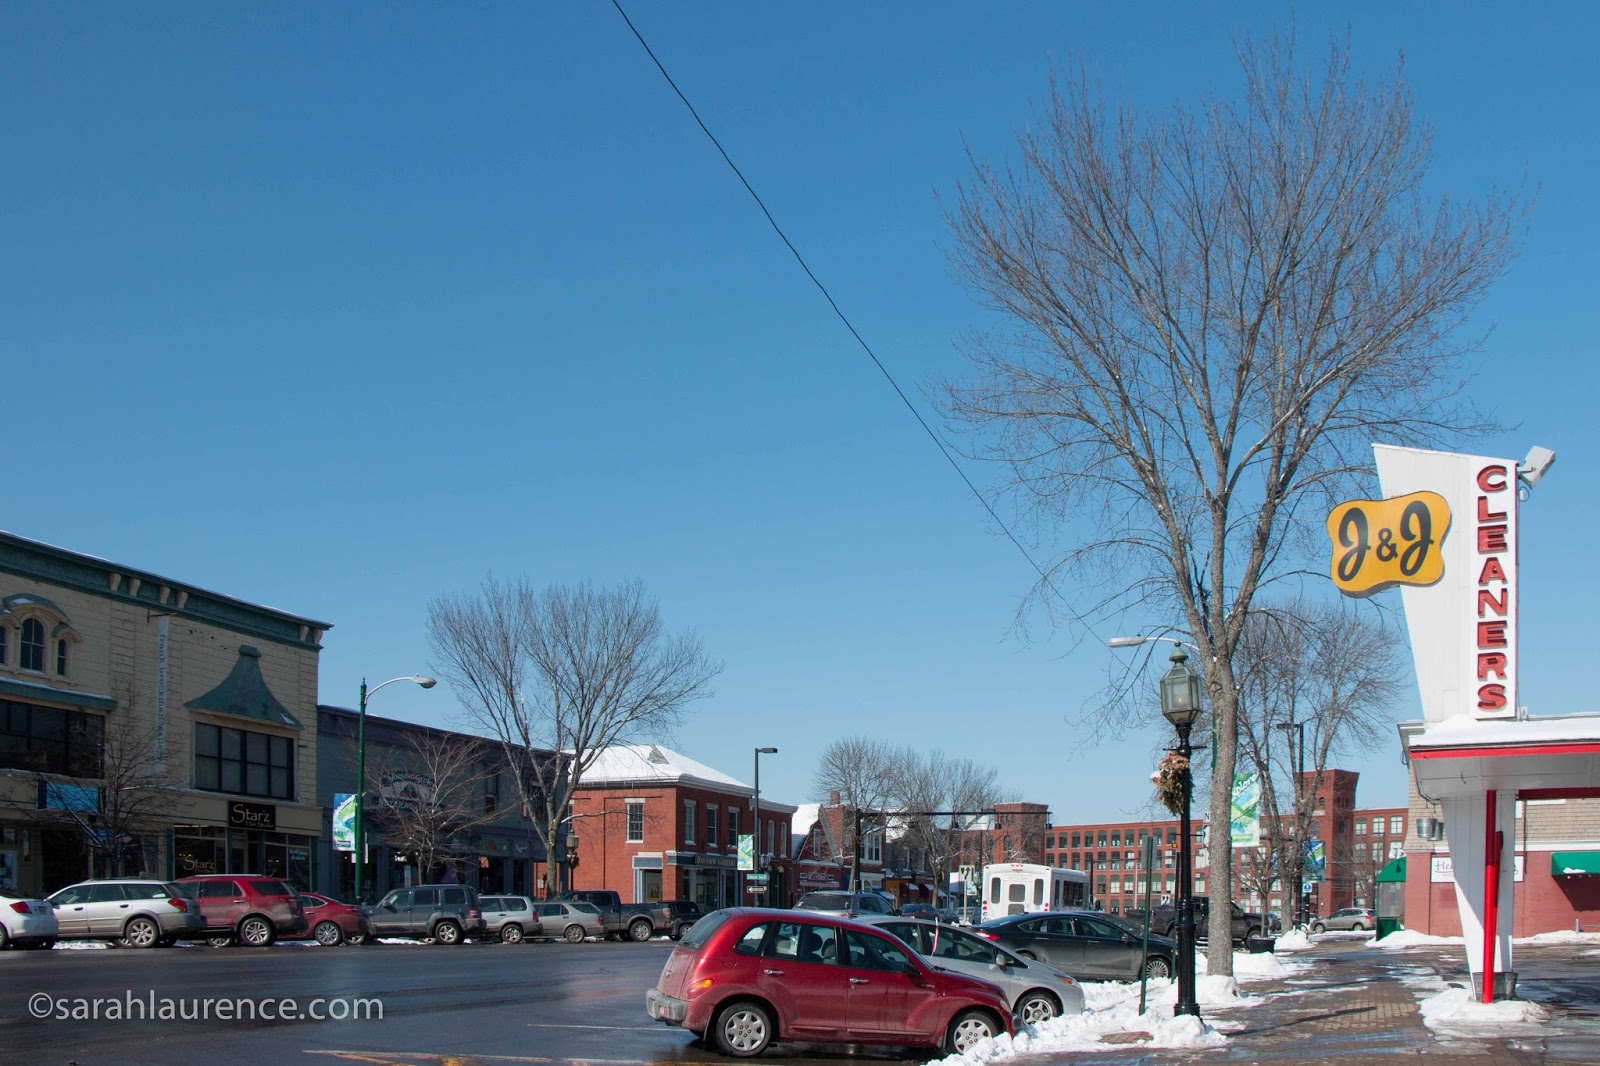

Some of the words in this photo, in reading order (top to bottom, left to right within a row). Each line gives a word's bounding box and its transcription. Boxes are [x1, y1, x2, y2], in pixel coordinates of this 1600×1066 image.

[1337, 507, 1371, 582] J
[1376, 527, 1398, 562] &
[1399, 500, 1434, 577] J
[1476, 464, 1508, 710] CLEANERS
